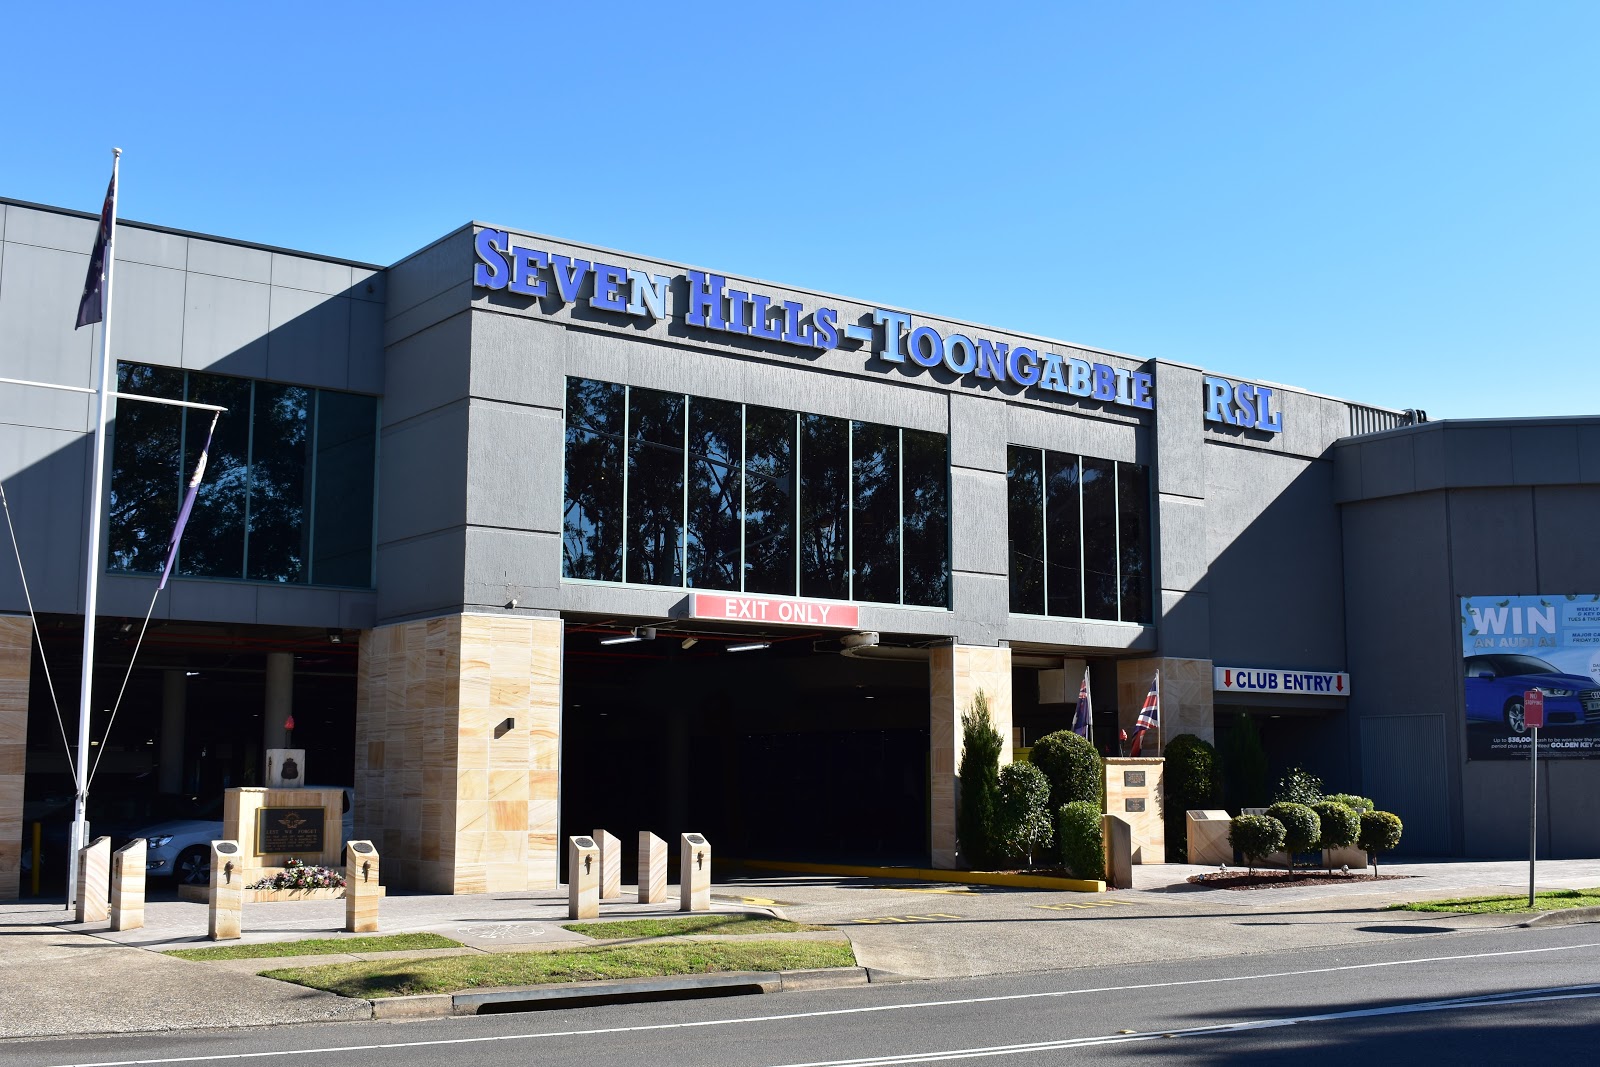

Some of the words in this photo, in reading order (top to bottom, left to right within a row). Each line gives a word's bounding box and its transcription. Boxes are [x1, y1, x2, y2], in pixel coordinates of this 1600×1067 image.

[474, 228, 671, 320] SEVEN
[1204, 375, 1282, 433] RSL
[725, 598, 770, 620] EXIT
[778, 602, 831, 624] ONLY
[1470, 606, 1557, 635] WIN
[1475, 637, 1495, 648] AN
[1499, 636, 1534, 648] AUDI
[1236, 671, 1278, 690] CLUB
[1283, 673, 1333, 692] ENTRY
